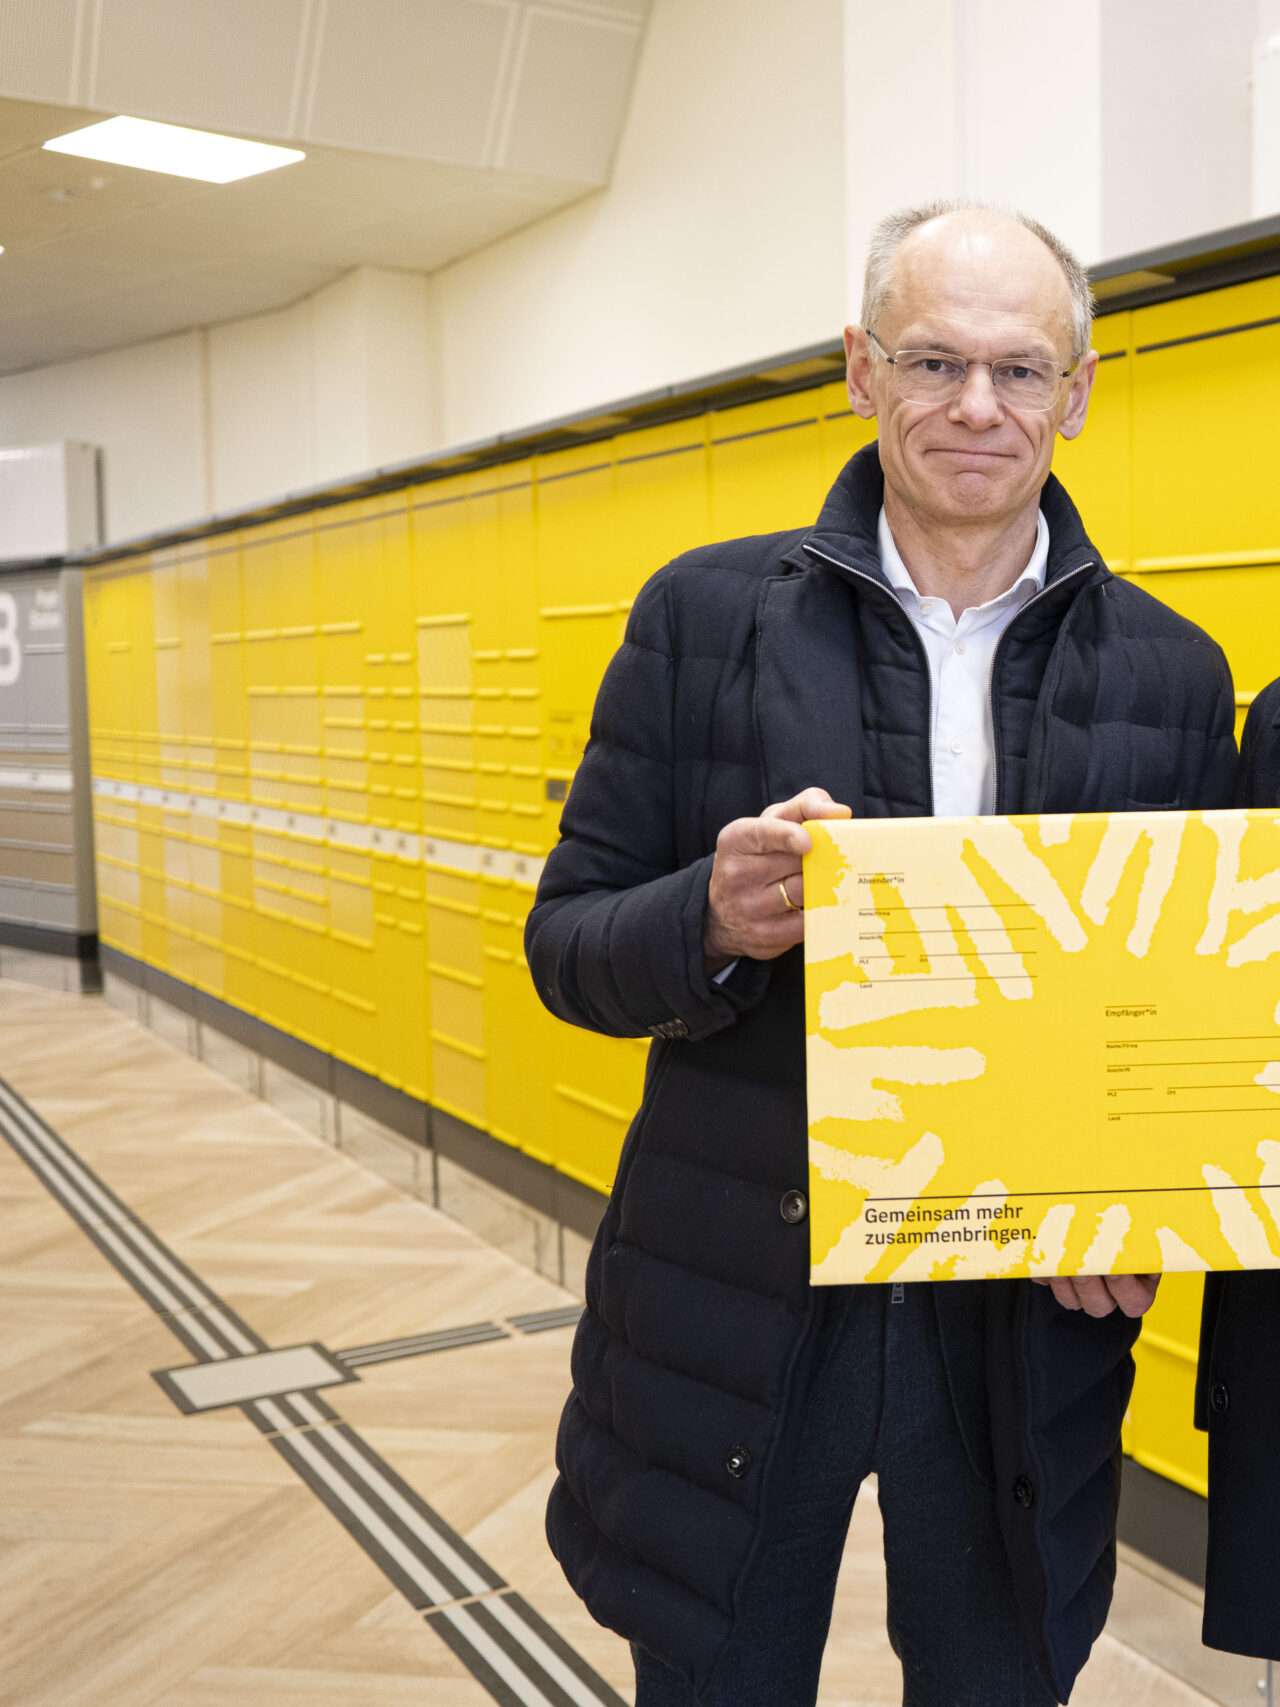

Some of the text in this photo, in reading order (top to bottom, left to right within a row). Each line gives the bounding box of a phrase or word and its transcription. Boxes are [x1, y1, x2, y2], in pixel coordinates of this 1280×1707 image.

[864, 1203, 1023, 1224] Gemeinsam mehr
[864, 1226, 1037, 1245] zusammenbringen.
